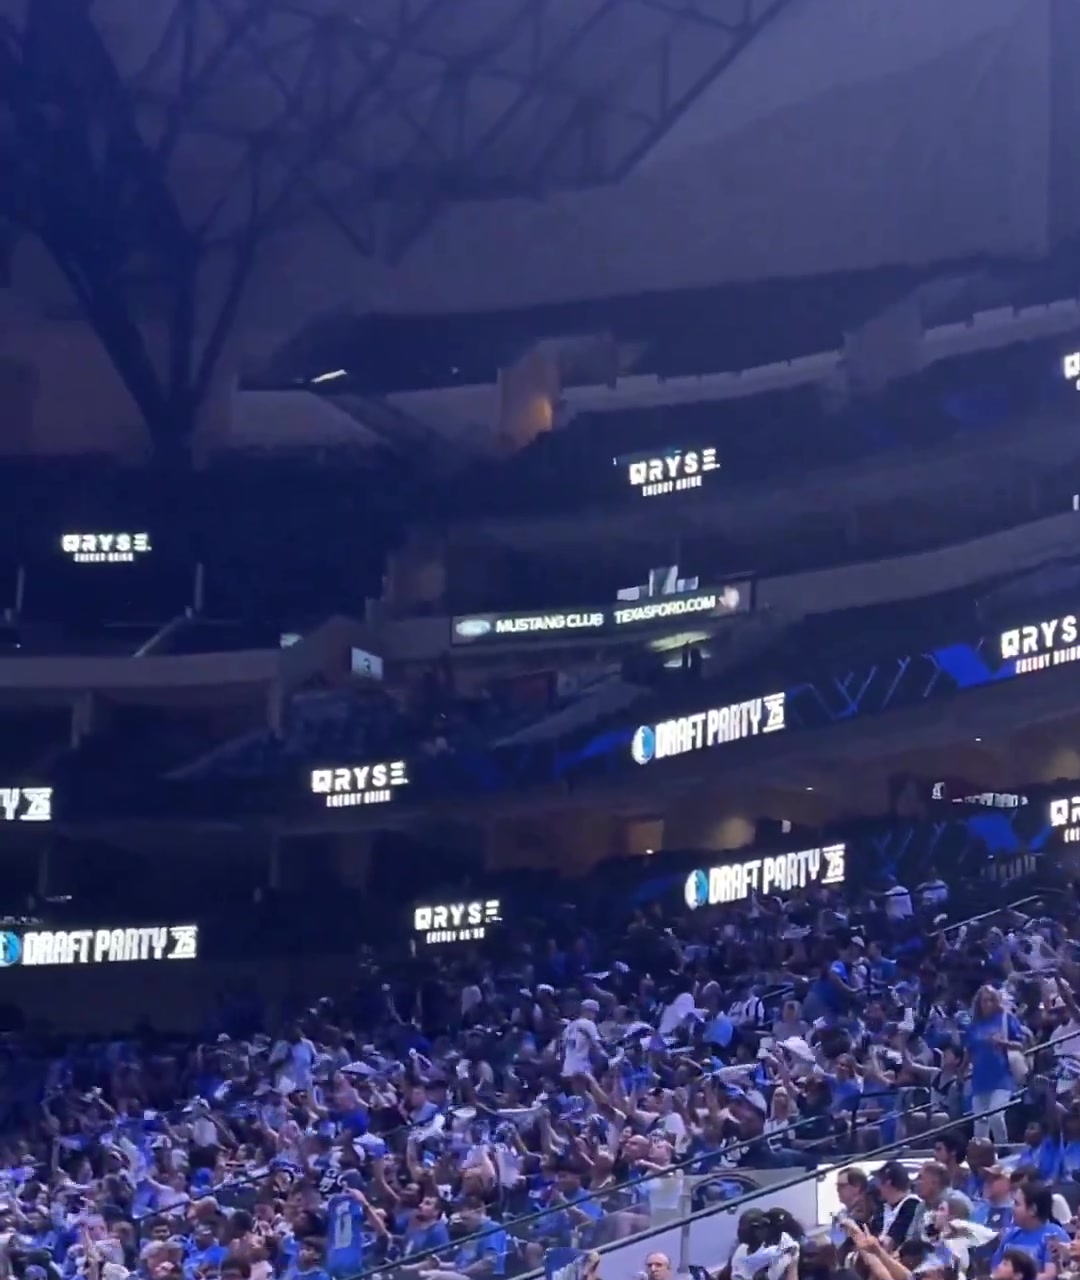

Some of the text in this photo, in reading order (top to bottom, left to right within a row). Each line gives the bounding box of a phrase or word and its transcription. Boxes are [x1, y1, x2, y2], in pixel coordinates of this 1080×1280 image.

[496, 614, 565, 633] MUSTANG
[566, 612, 604, 628] CLUB
[655, 712, 706, 759] DRAFT
[707, 698, 763, 747] PARTY
[708, 859, 762, 905] DRAFT
[763, 848, 821, 895] PARTY
[22, 929, 94, 967] DRAFT
[94, 926, 168, 962] PARTY
